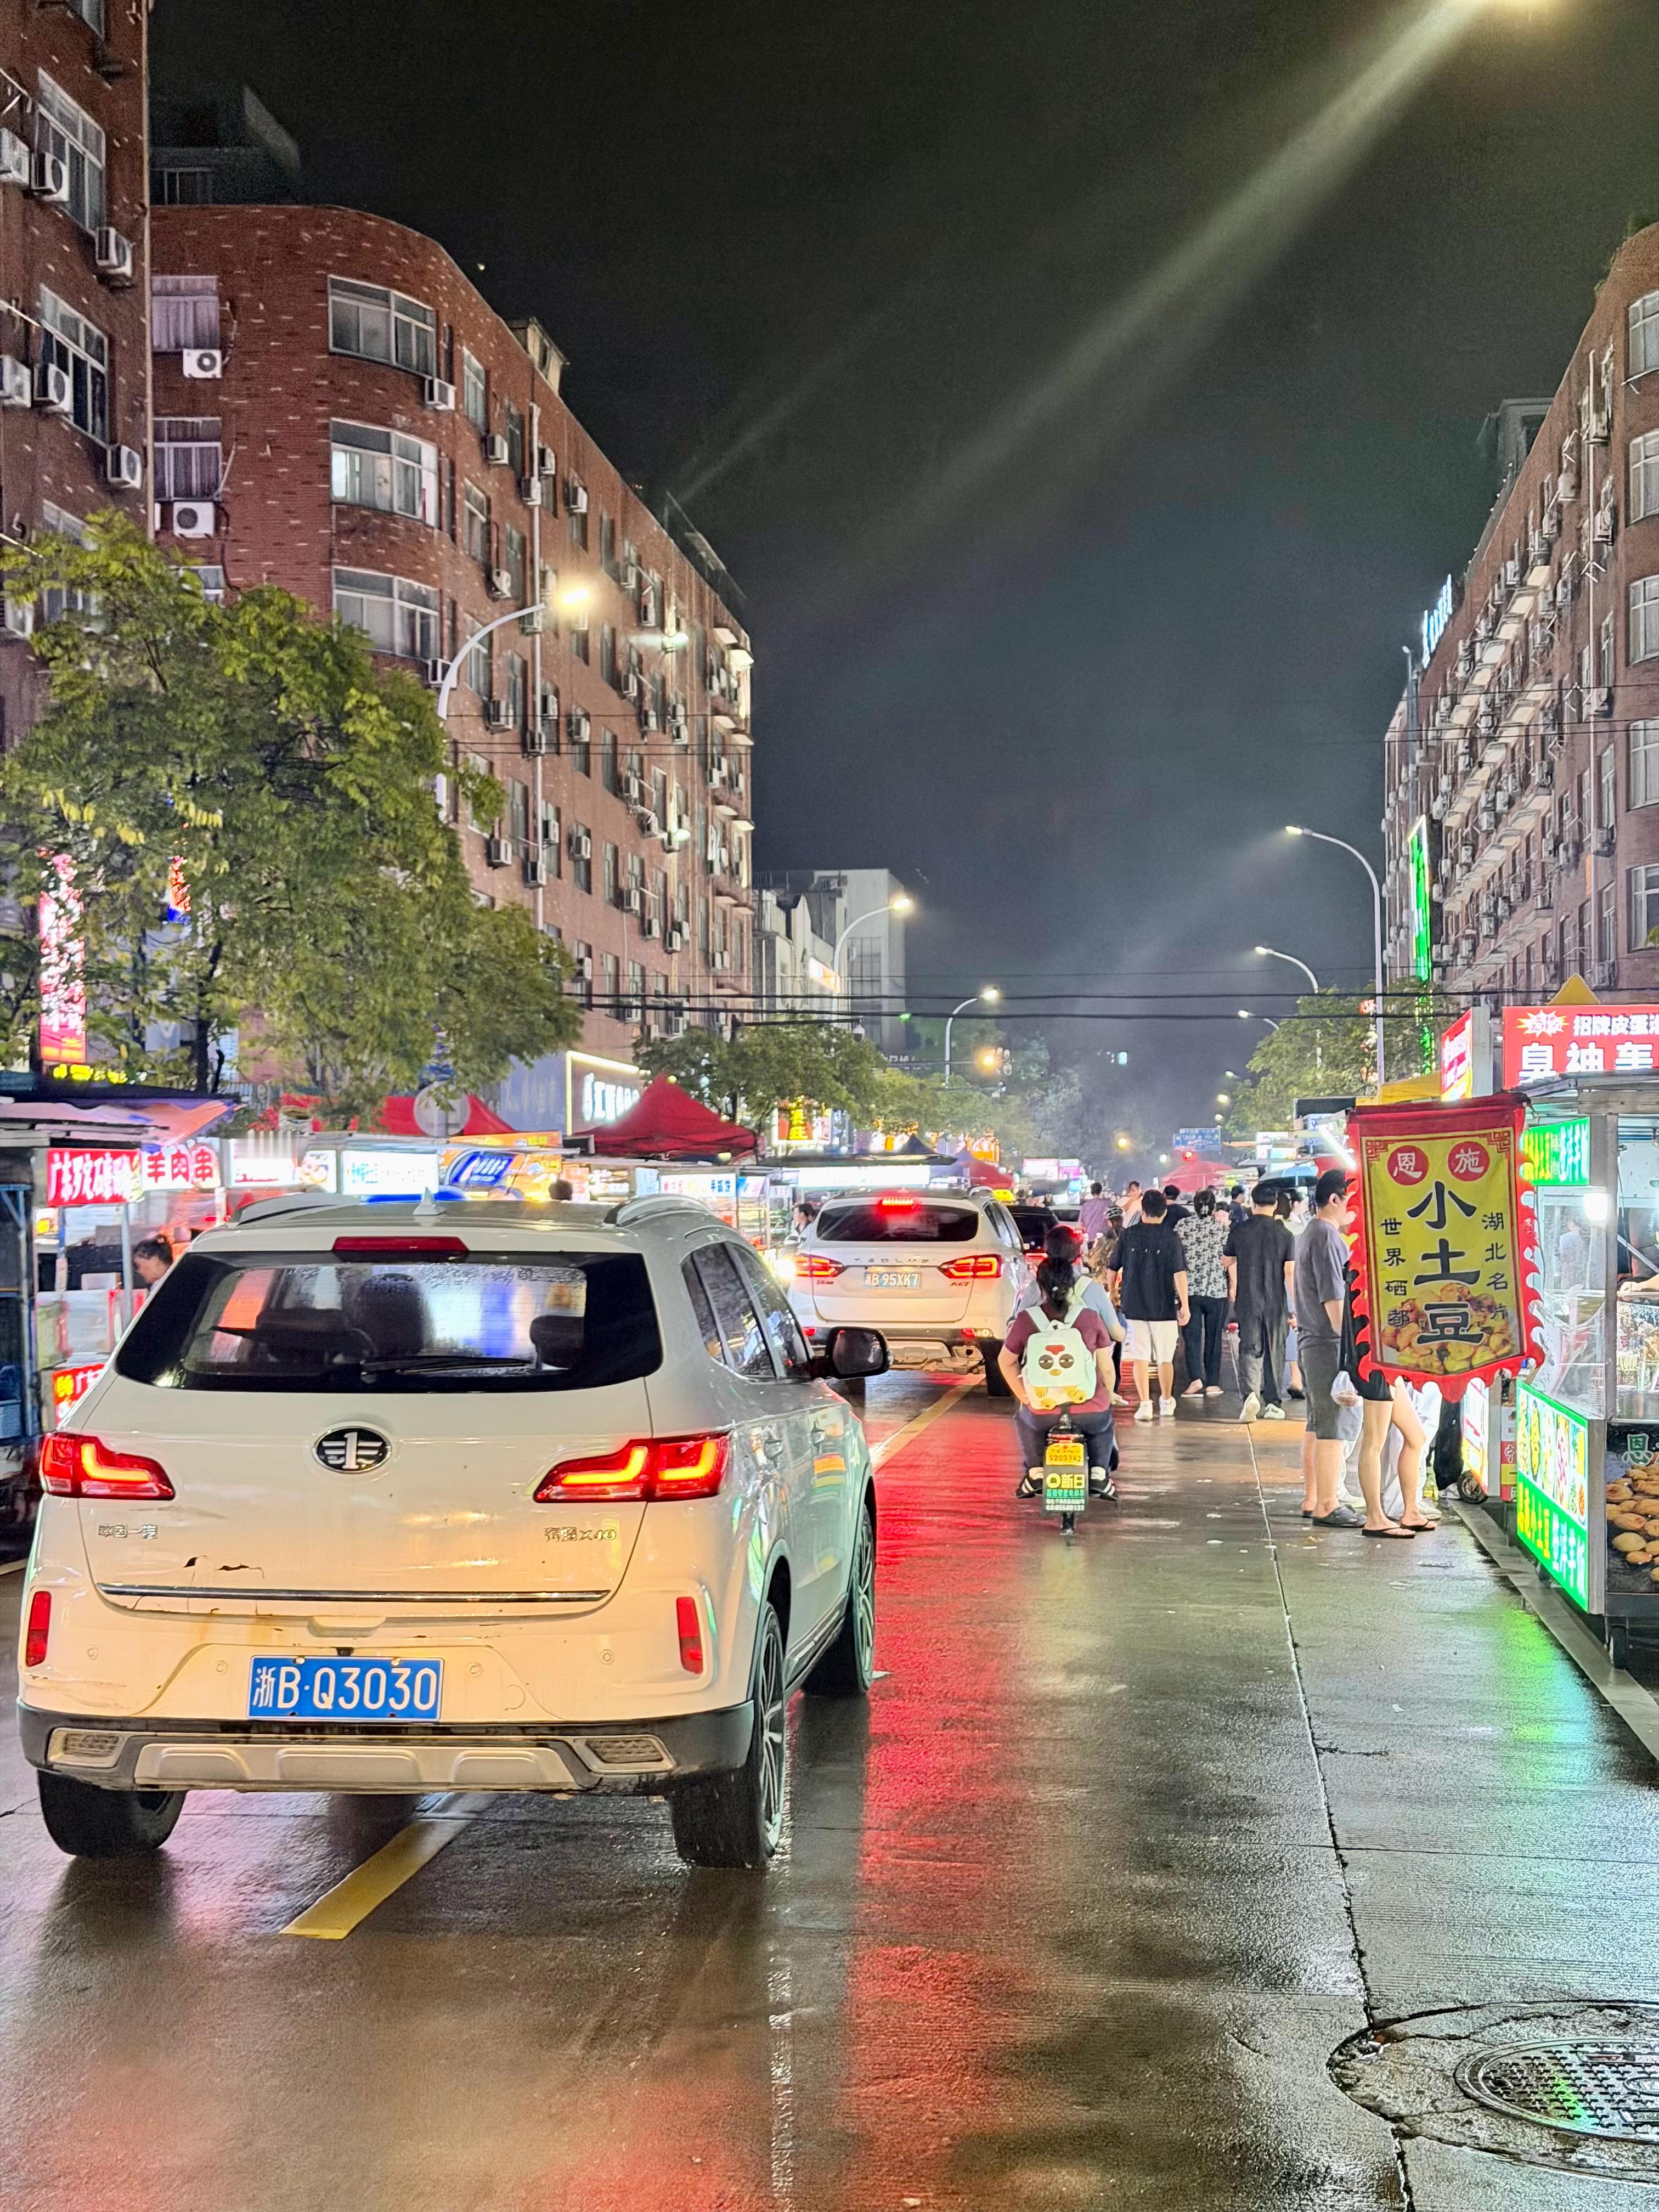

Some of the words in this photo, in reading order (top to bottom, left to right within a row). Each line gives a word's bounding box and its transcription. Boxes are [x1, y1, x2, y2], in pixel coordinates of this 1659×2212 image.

[146, 1148, 213, 1183] 羊肉串
[1393, 1148, 1484, 1178] 恩施
[1381, 1218, 1410, 1327] 世界硒都
[1406, 1181, 1484, 1345] 小土豆
[252, 1666, 437, 1711] 浙B·Q3030
